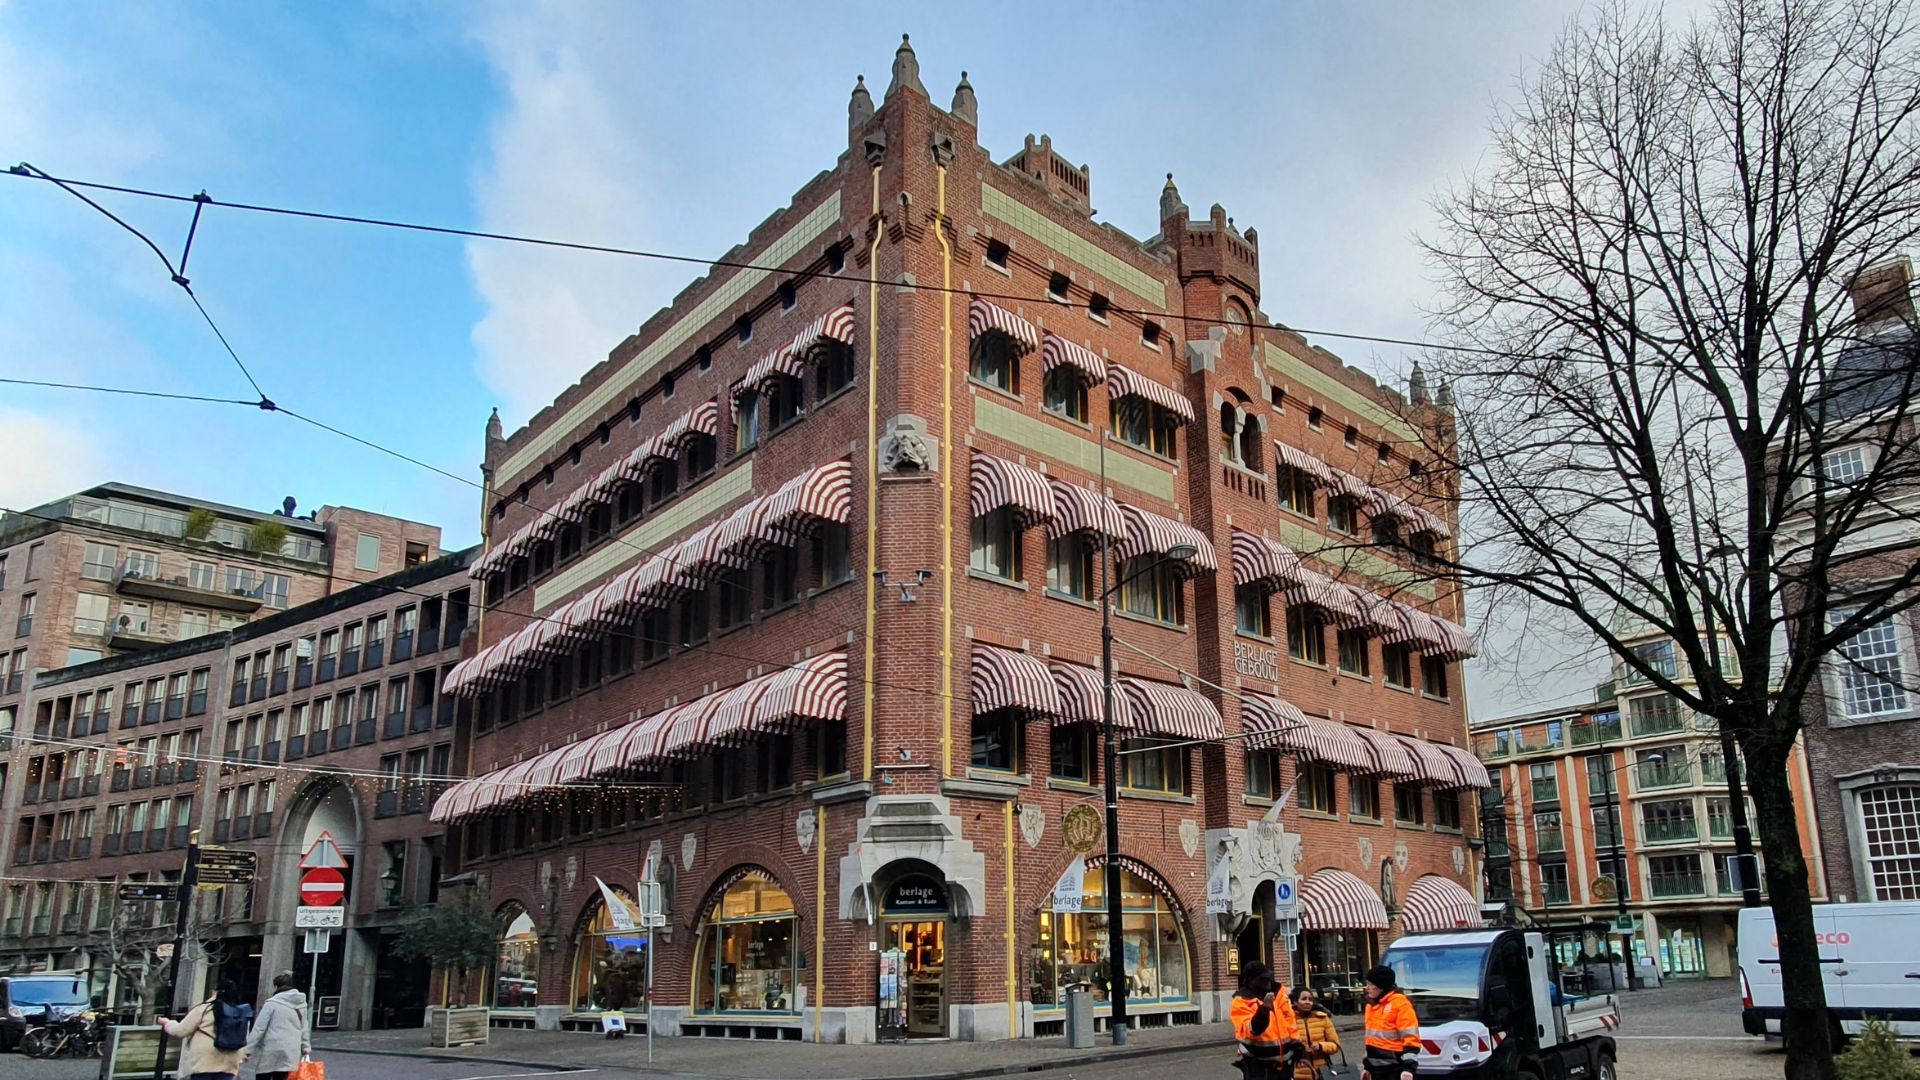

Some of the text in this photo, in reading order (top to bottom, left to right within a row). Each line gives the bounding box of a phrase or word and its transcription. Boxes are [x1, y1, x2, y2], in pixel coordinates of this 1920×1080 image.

[1234, 640, 1277, 667] BERLAGE
[1235, 657, 1277, 681] GEBOUW
[900, 886, 933, 898] berlage
[1053, 895, 1081, 908] berlage
[1816, 932, 1850, 945] eco
